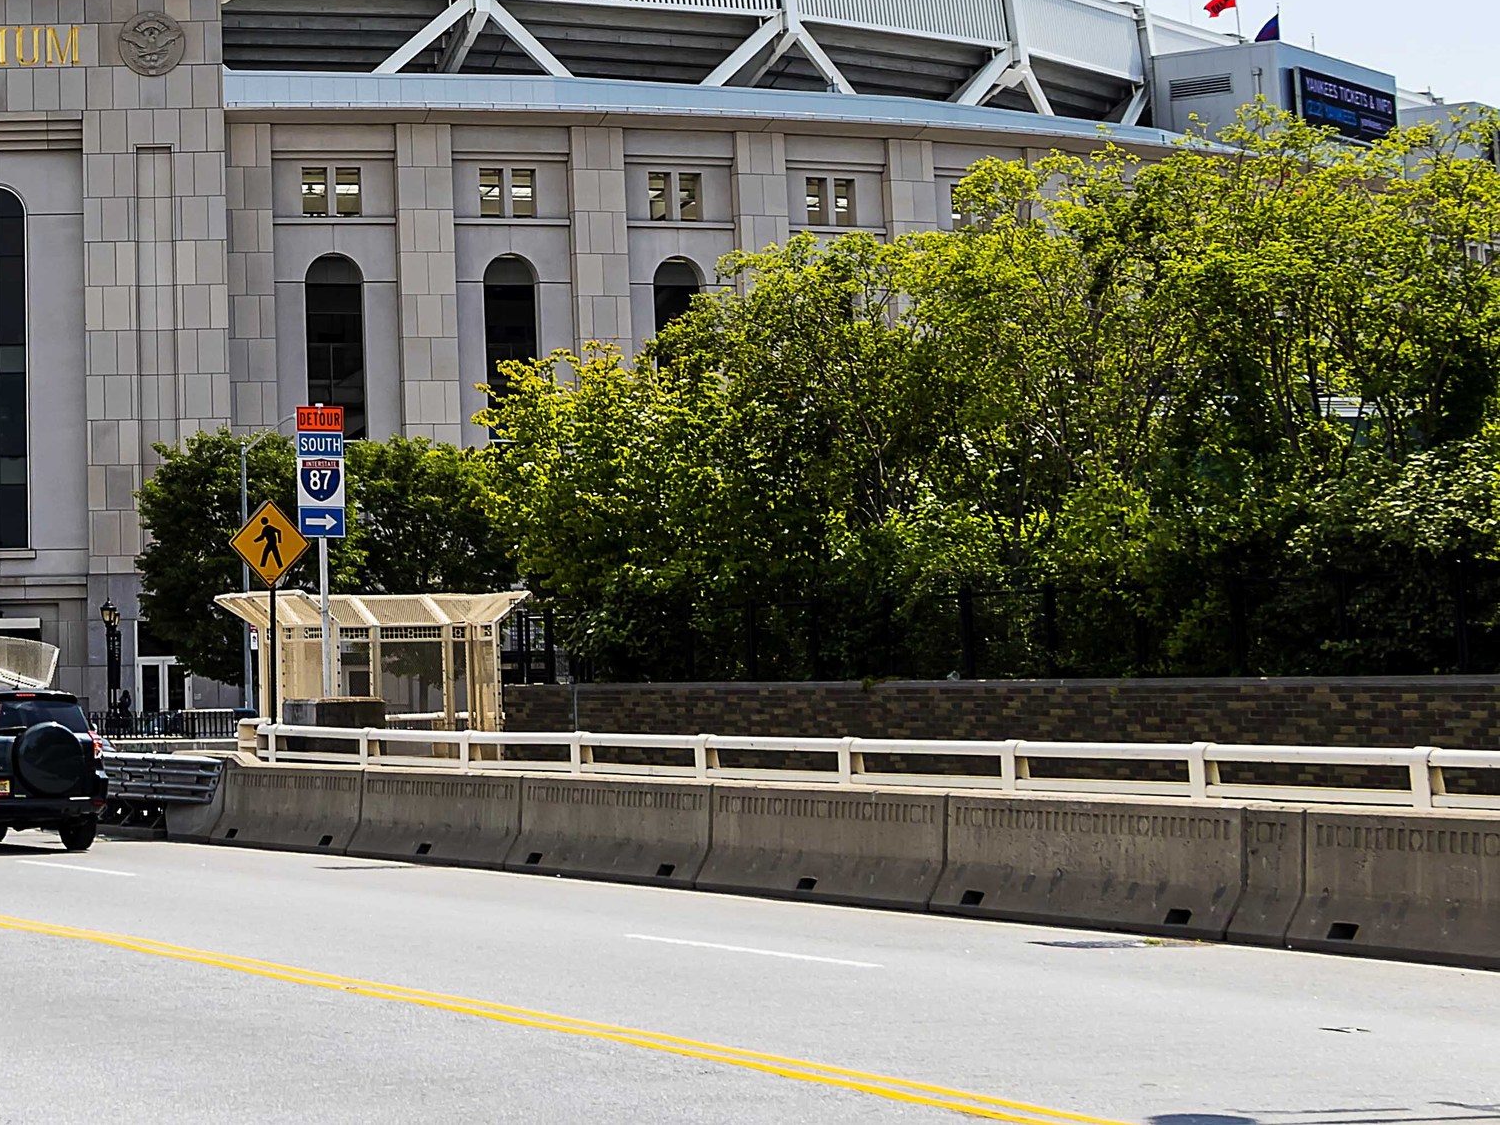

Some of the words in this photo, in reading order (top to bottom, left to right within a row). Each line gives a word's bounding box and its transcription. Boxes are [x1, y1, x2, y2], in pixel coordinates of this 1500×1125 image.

[1305, 76, 1338, 99] YANKEES
[1338, 86, 1368, 108] TICKETS
[299, 412, 341, 426] DETOUR
[300, 437, 341, 452] SOUTH
[309, 469, 332, 490] 87
